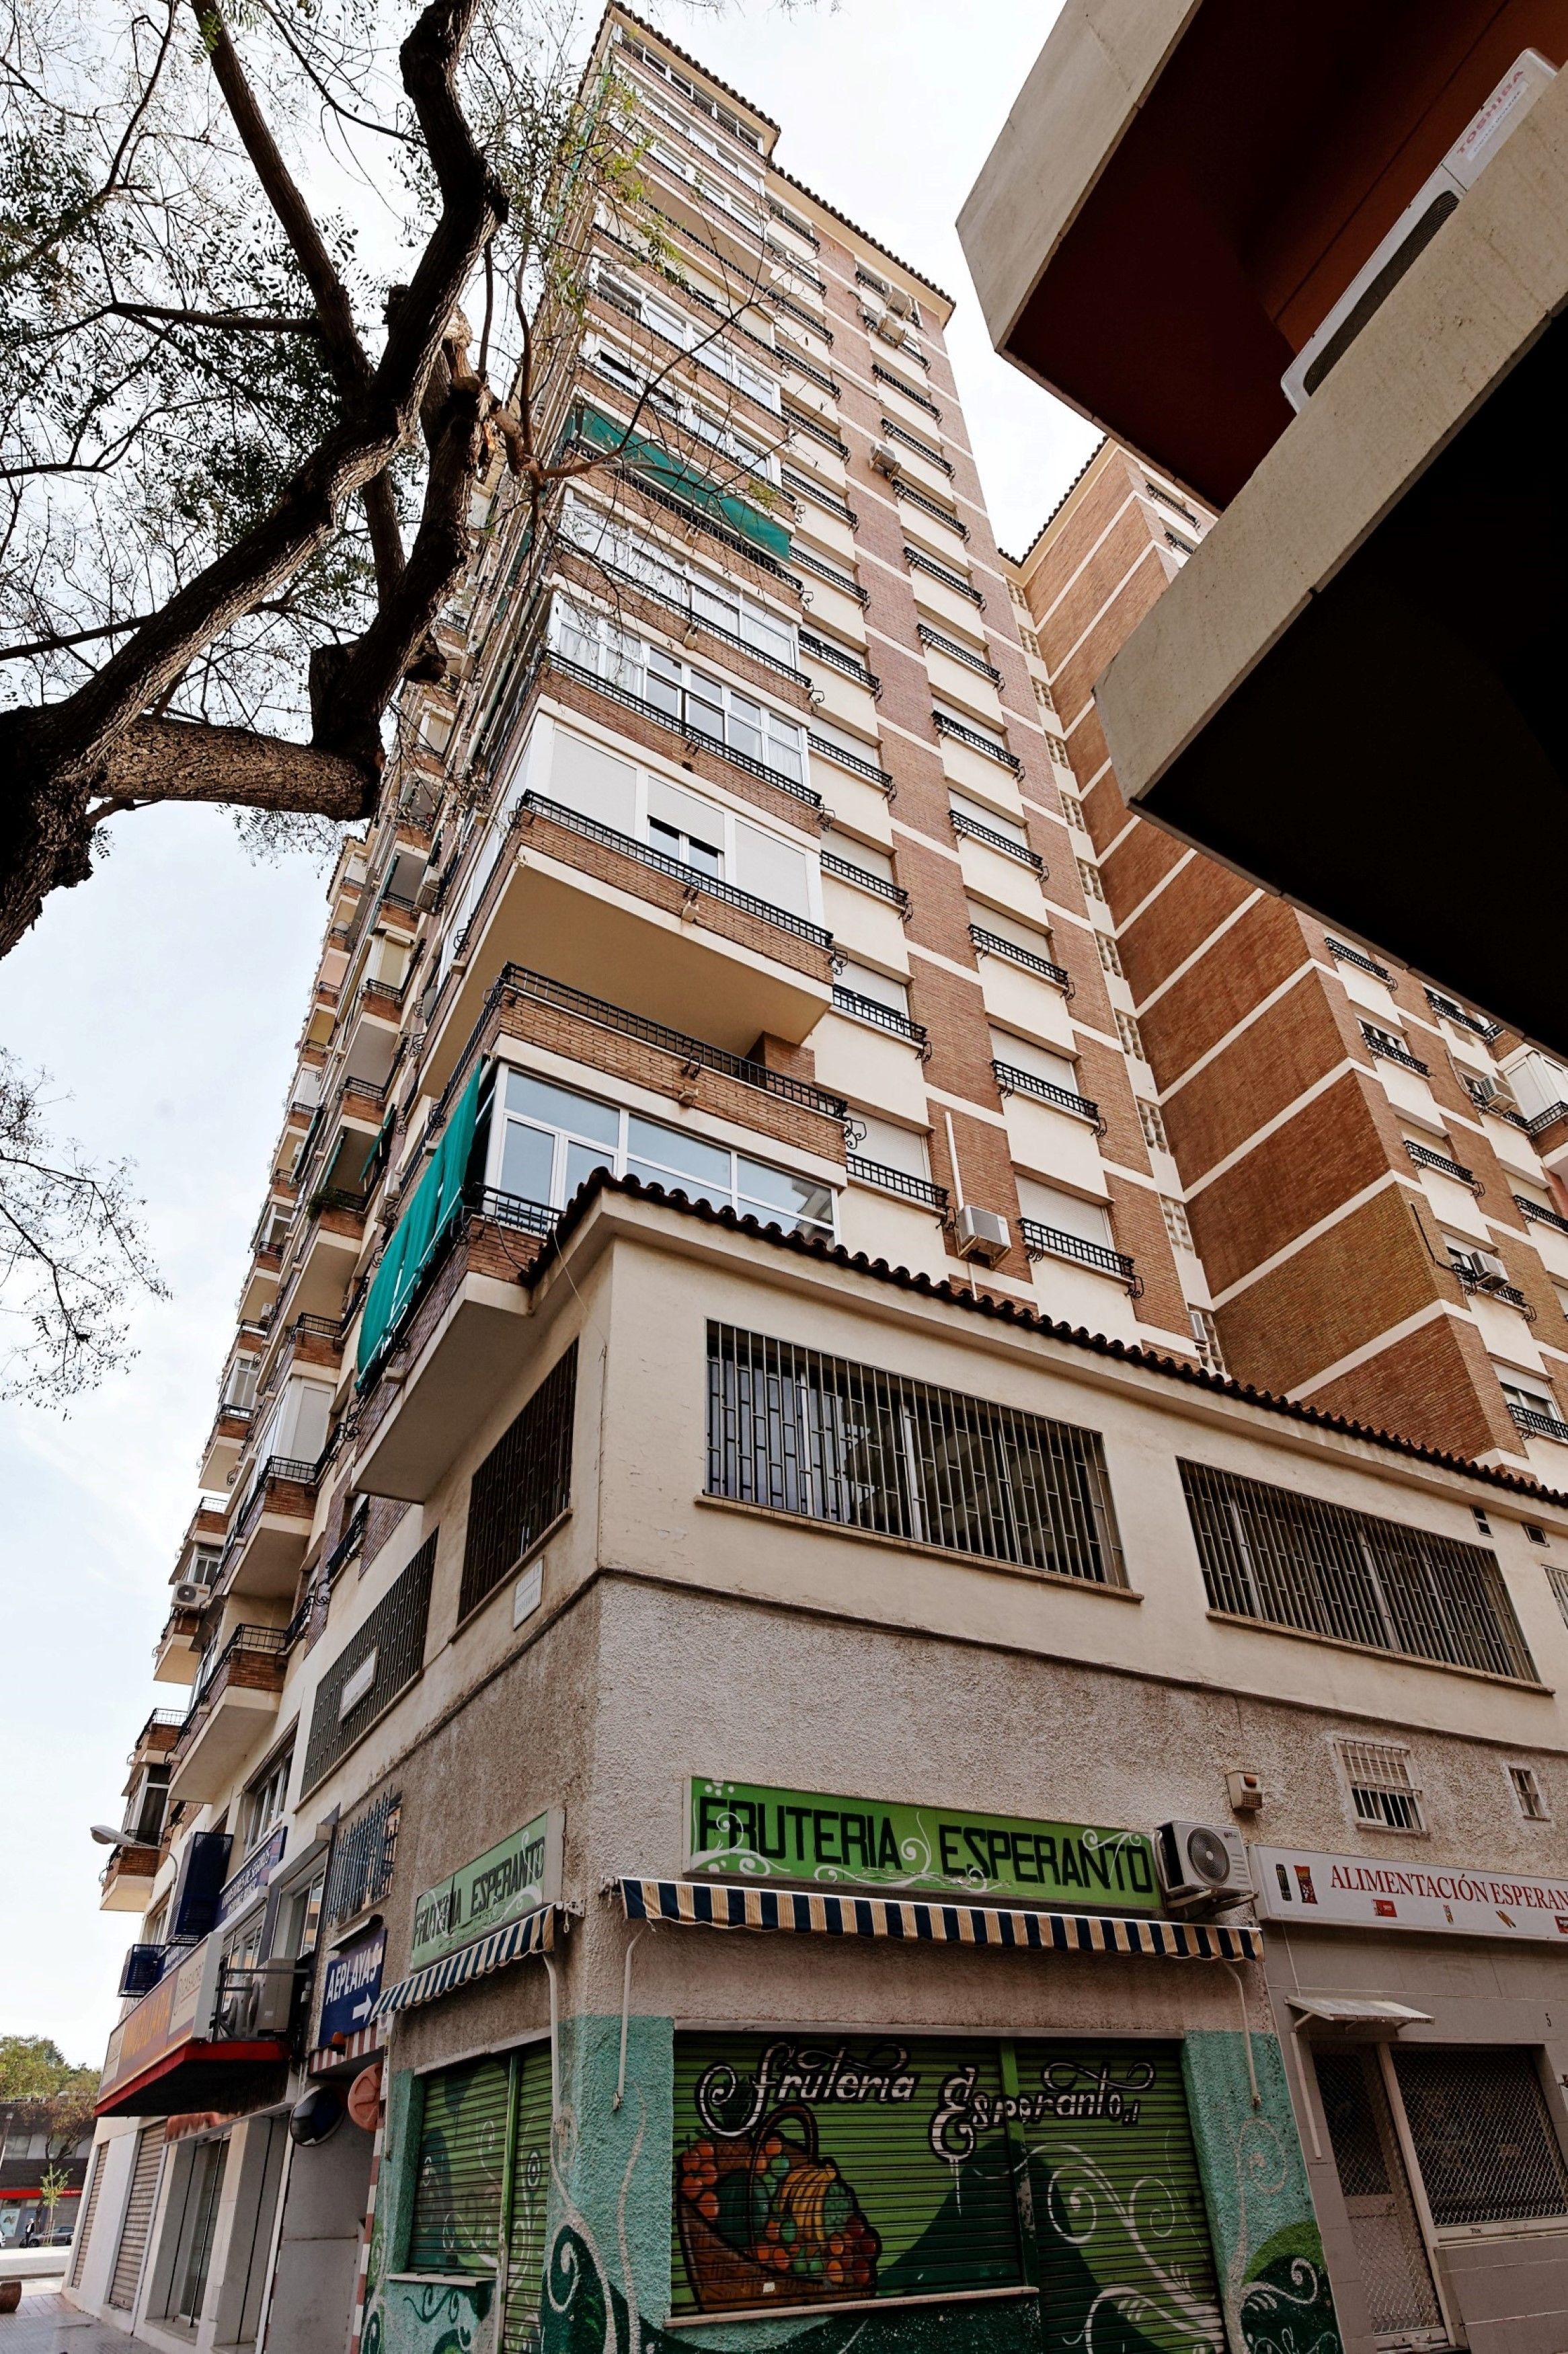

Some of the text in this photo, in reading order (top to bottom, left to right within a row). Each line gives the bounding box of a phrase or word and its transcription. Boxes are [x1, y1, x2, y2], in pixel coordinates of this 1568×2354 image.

[1456, 70, 1524, 154] TOSHIBA
[471, 1836, 545, 1918] ESPERANTO
[699, 1796, 1154, 1893] FRUTERIA ESPERANTO
[1330, 1864, 1489, 1903] ALIMENTACIÓN
[325, 1942, 383, 2006] AEPLAYAS
